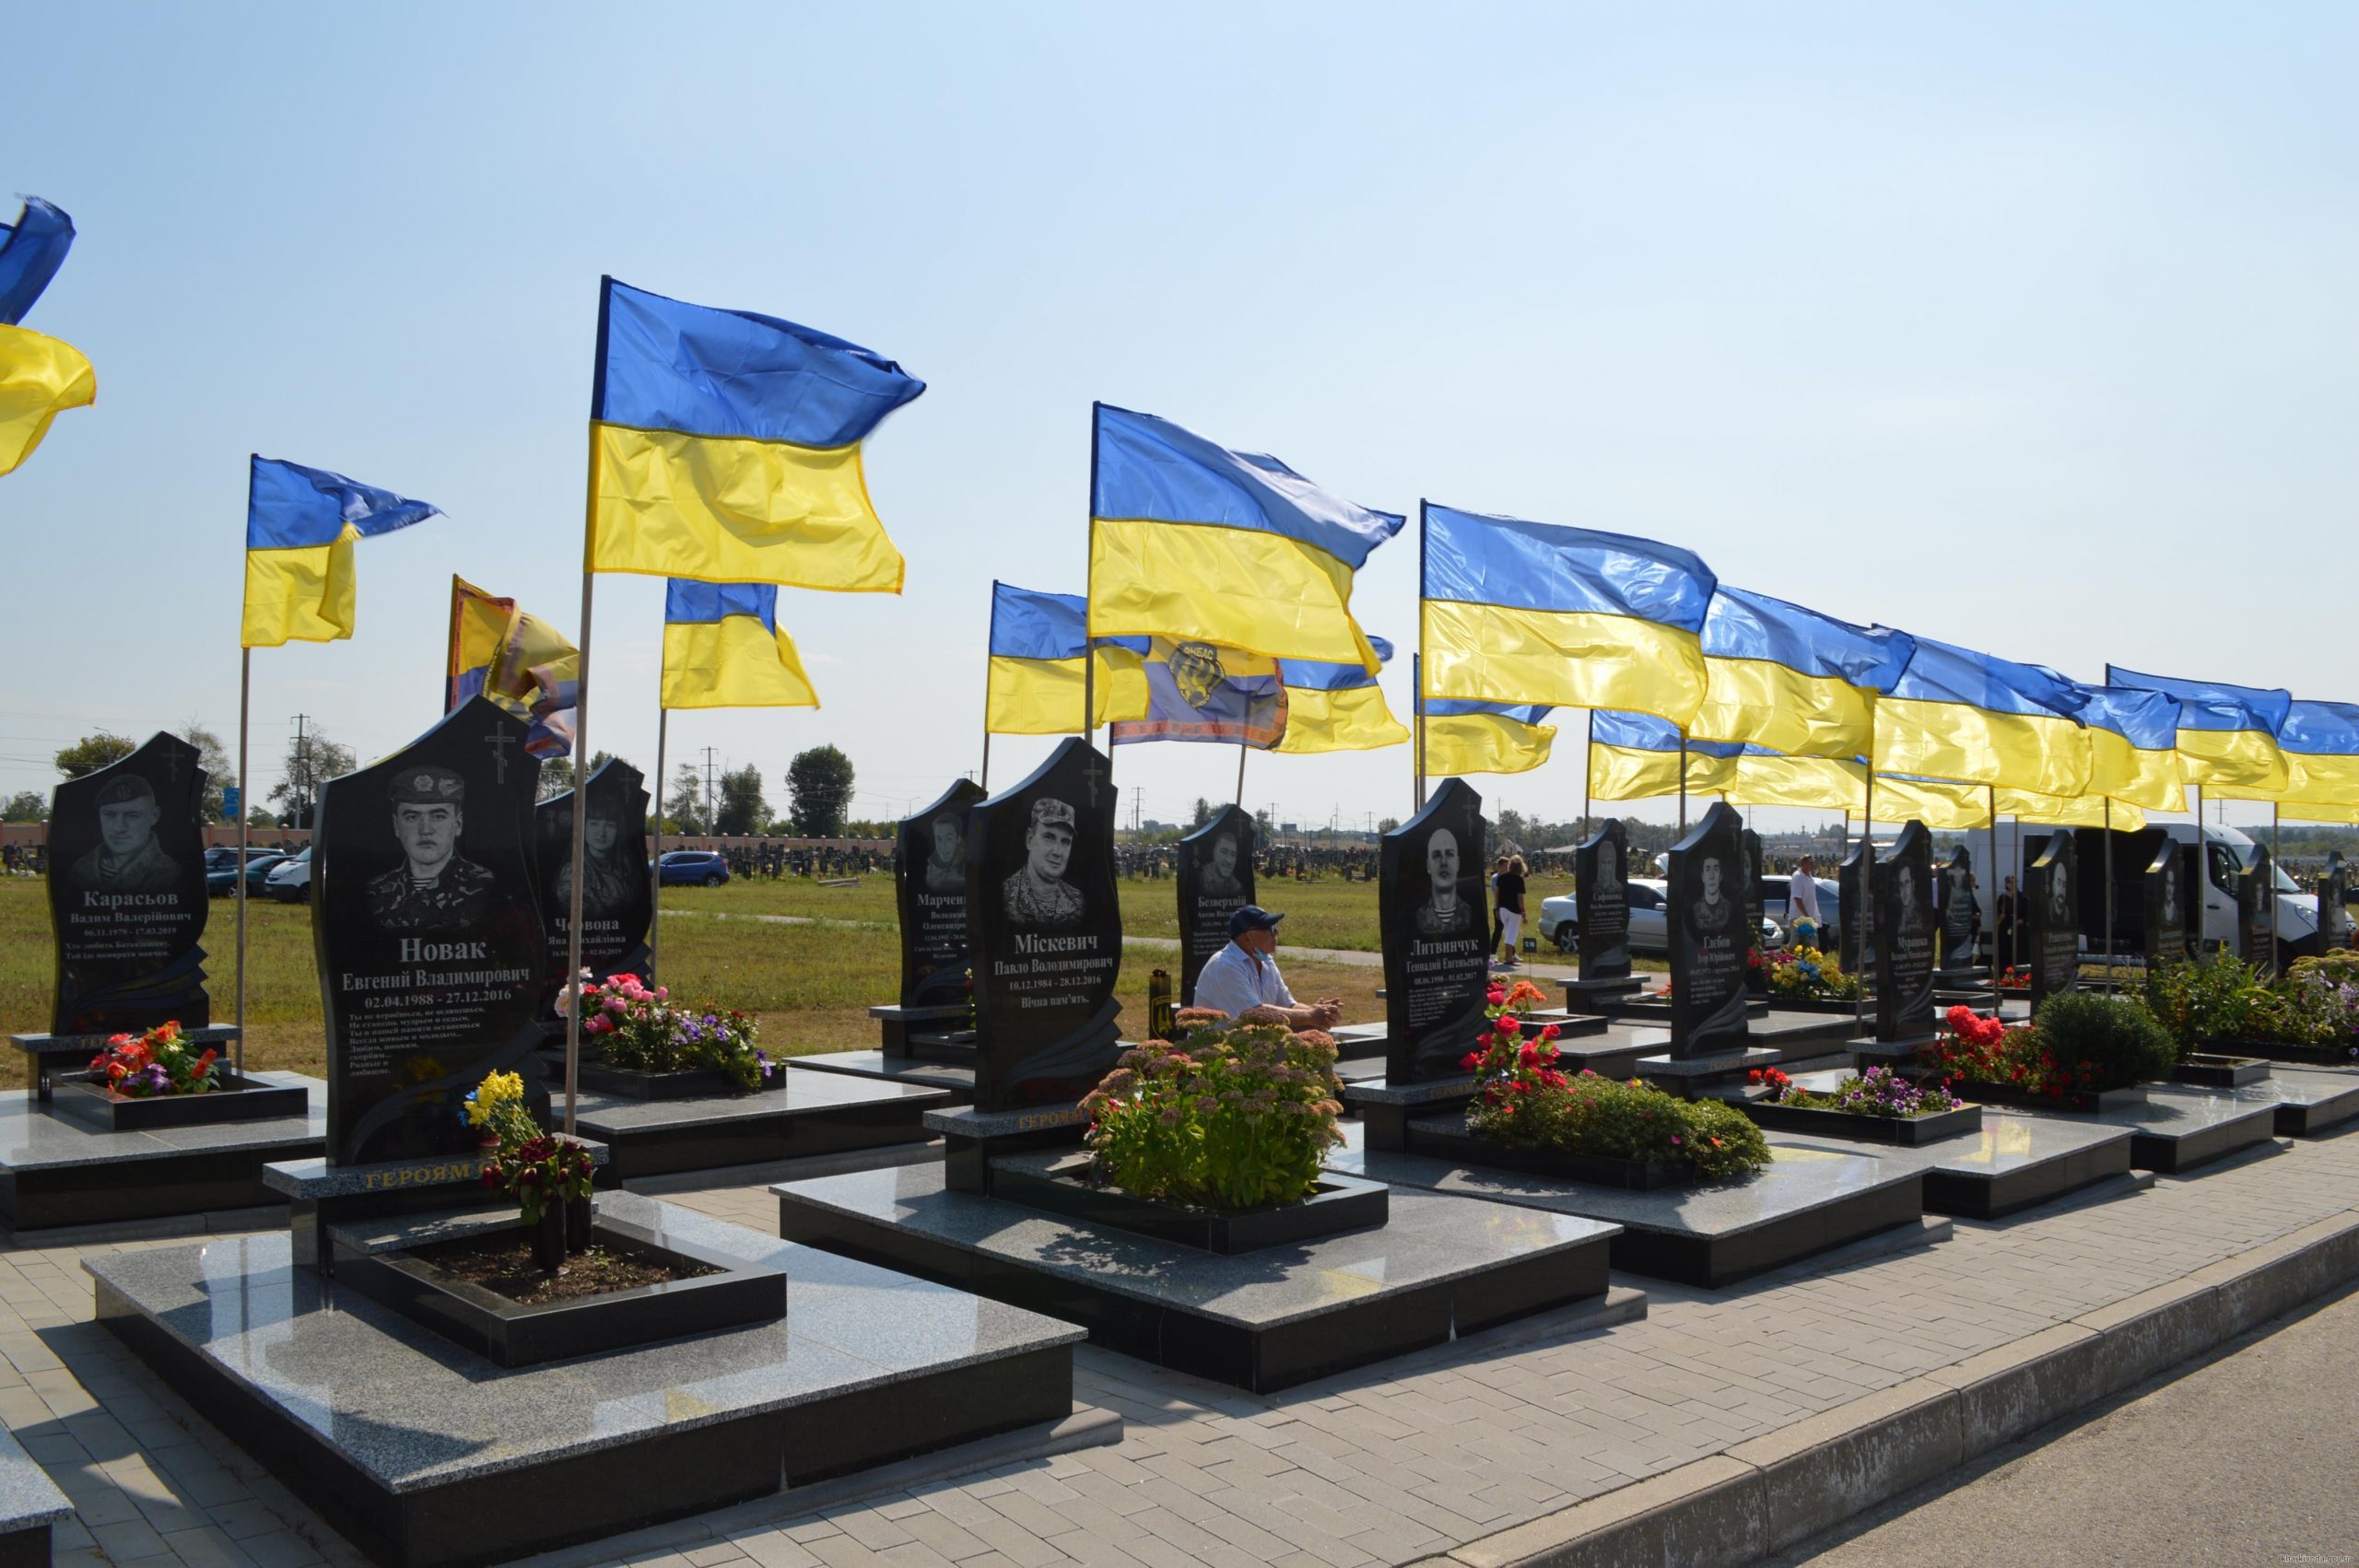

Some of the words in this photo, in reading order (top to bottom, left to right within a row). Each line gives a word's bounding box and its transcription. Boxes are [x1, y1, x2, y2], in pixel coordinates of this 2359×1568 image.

[84, 892, 179, 910] Карасьов
[917, 894, 966, 908] Марчен
[1198, 895, 1246, 909] Безверхній
[70, 913, 111, 923] Вадим
[114, 911, 192, 924] Валерійович
[555, 918, 619, 931] Чевона
[547, 936, 567, 945] Яна
[581, 935, 626, 943] ихайлівна
[1015, 933, 1098, 954] Міскевич
[398, 938, 487, 963] Новак
[1410, 939, 1479, 956] Литвинчук
[995, 961, 1029, 976] Павло
[1031, 957, 1113, 973] Володимирович
[1406, 959, 1441, 973] Геннадий
[342, 970, 411, 991] Евгений
[416, 967, 531, 989] Владимирович
[1009, 978, 1052, 990] 10.12.1984
[1060, 975, 1102, 987] 28.12.2016
[364, 993, 434, 1009] 02.04.1988
[445, 989, 511, 1004] 27.12.2016
[1021, 997, 1048, 1009] Вічна
[400, 1018, 433, 1026] мудрым
[433, 1023, 480, 1032] останешься
[367, 1164, 471, 1189] ГЕРОЯМ
